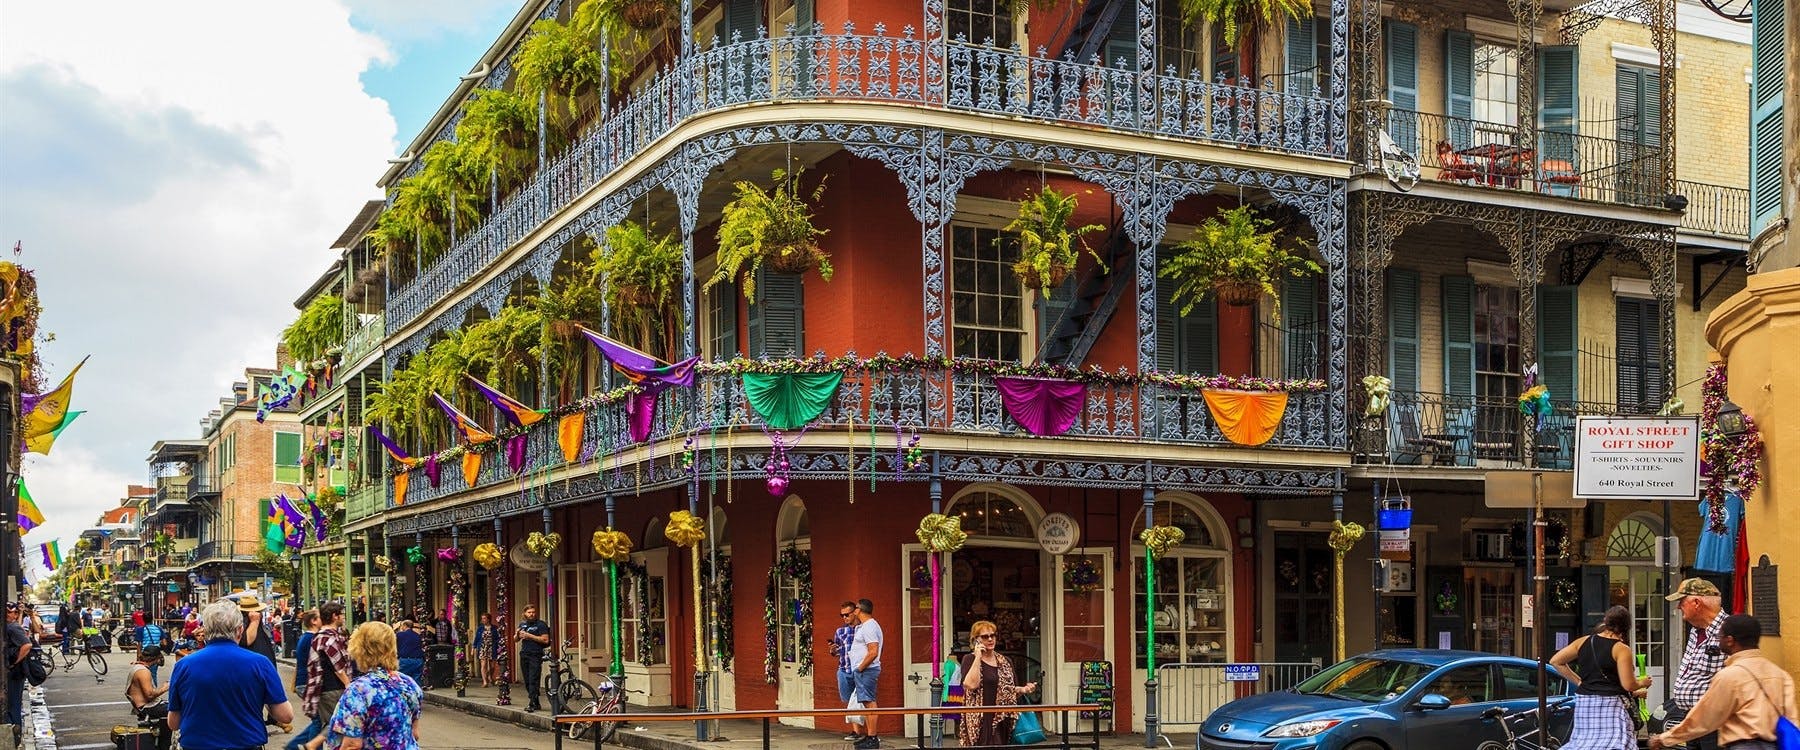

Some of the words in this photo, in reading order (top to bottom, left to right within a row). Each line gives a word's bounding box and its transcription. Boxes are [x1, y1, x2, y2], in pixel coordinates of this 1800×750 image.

[1588, 427, 1633, 436] ROYAL
[1636, 427, 1689, 436] STREET
[1602, 440, 1634, 449] GIFT
[1638, 440, 1674, 449] SHOP
[1617, 479, 1644, 489] Royal
[1646, 479, 1674, 488] Street
